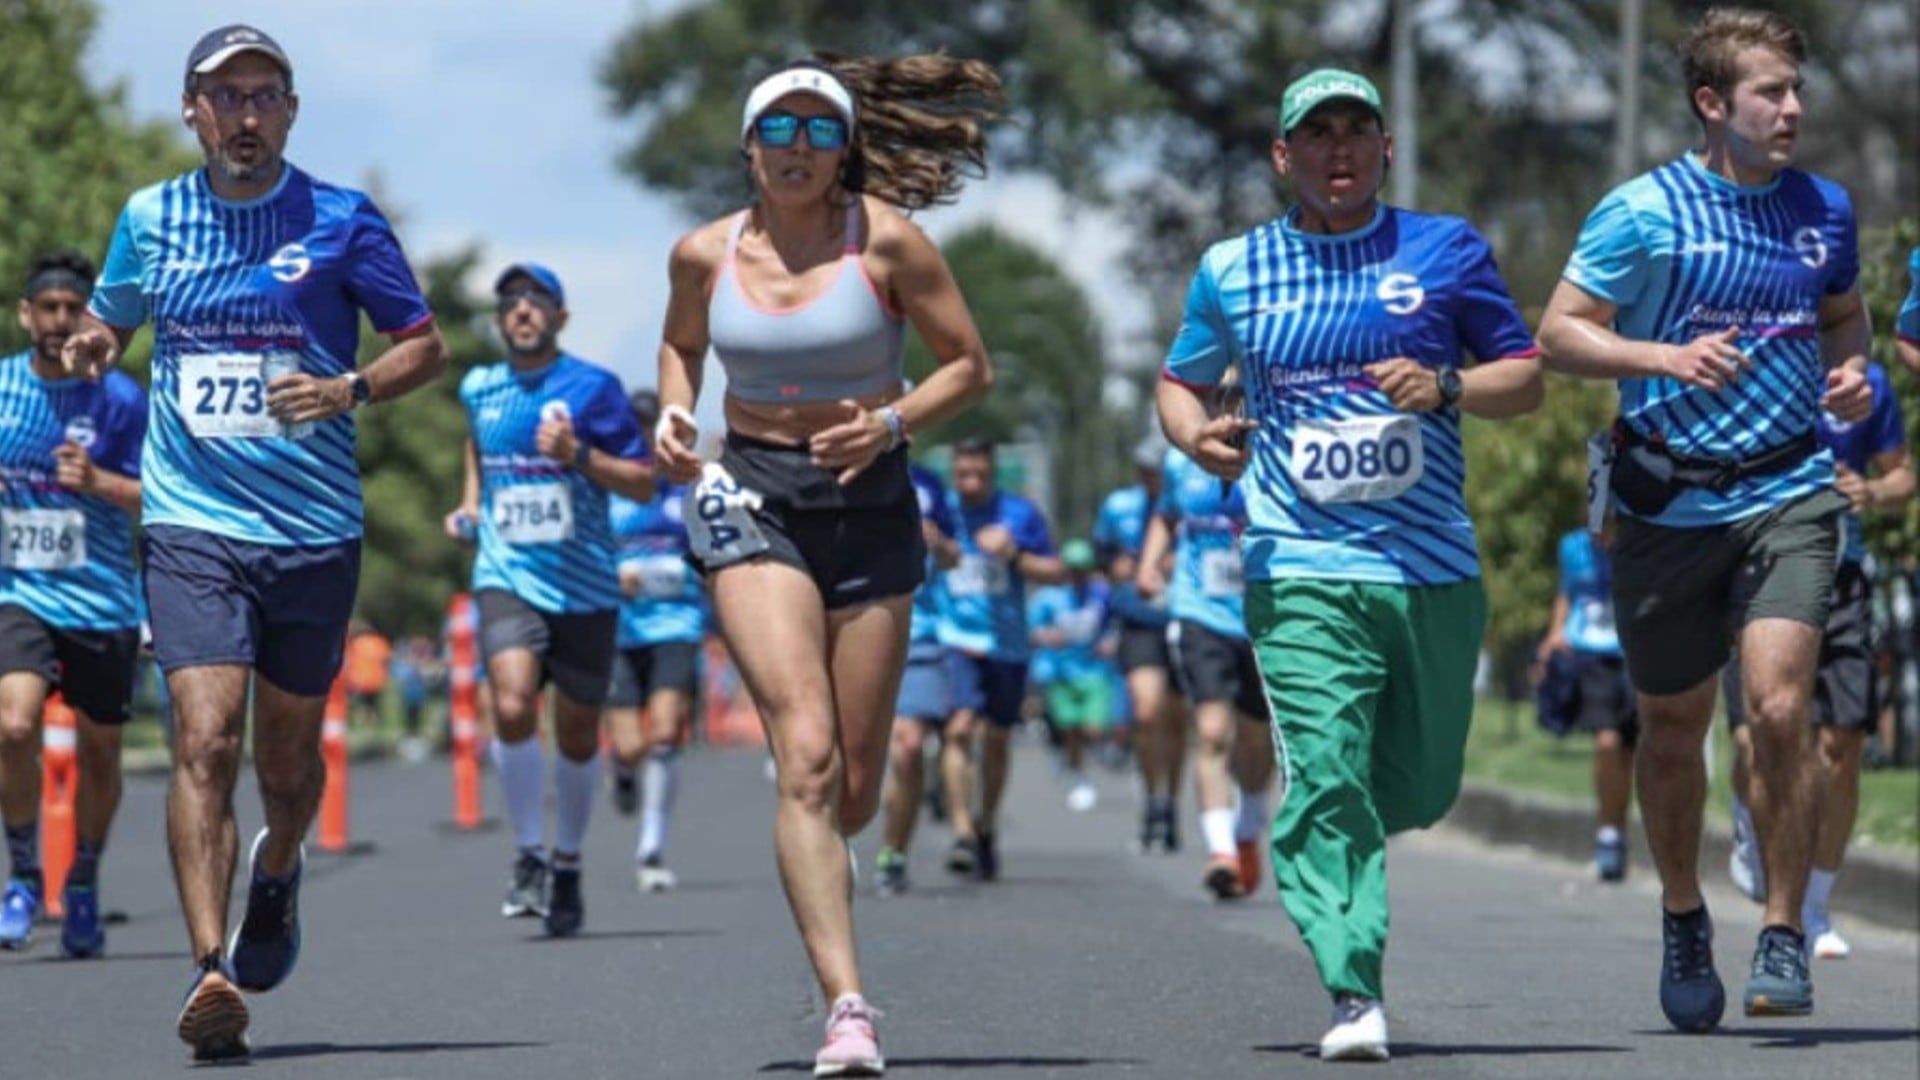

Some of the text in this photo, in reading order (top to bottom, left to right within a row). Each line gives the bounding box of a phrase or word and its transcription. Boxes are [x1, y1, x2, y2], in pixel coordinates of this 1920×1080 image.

[1302, 437, 1411, 480] 2080
[499, 499, 562, 526] 2784
[9, 525, 73, 553] 2786
